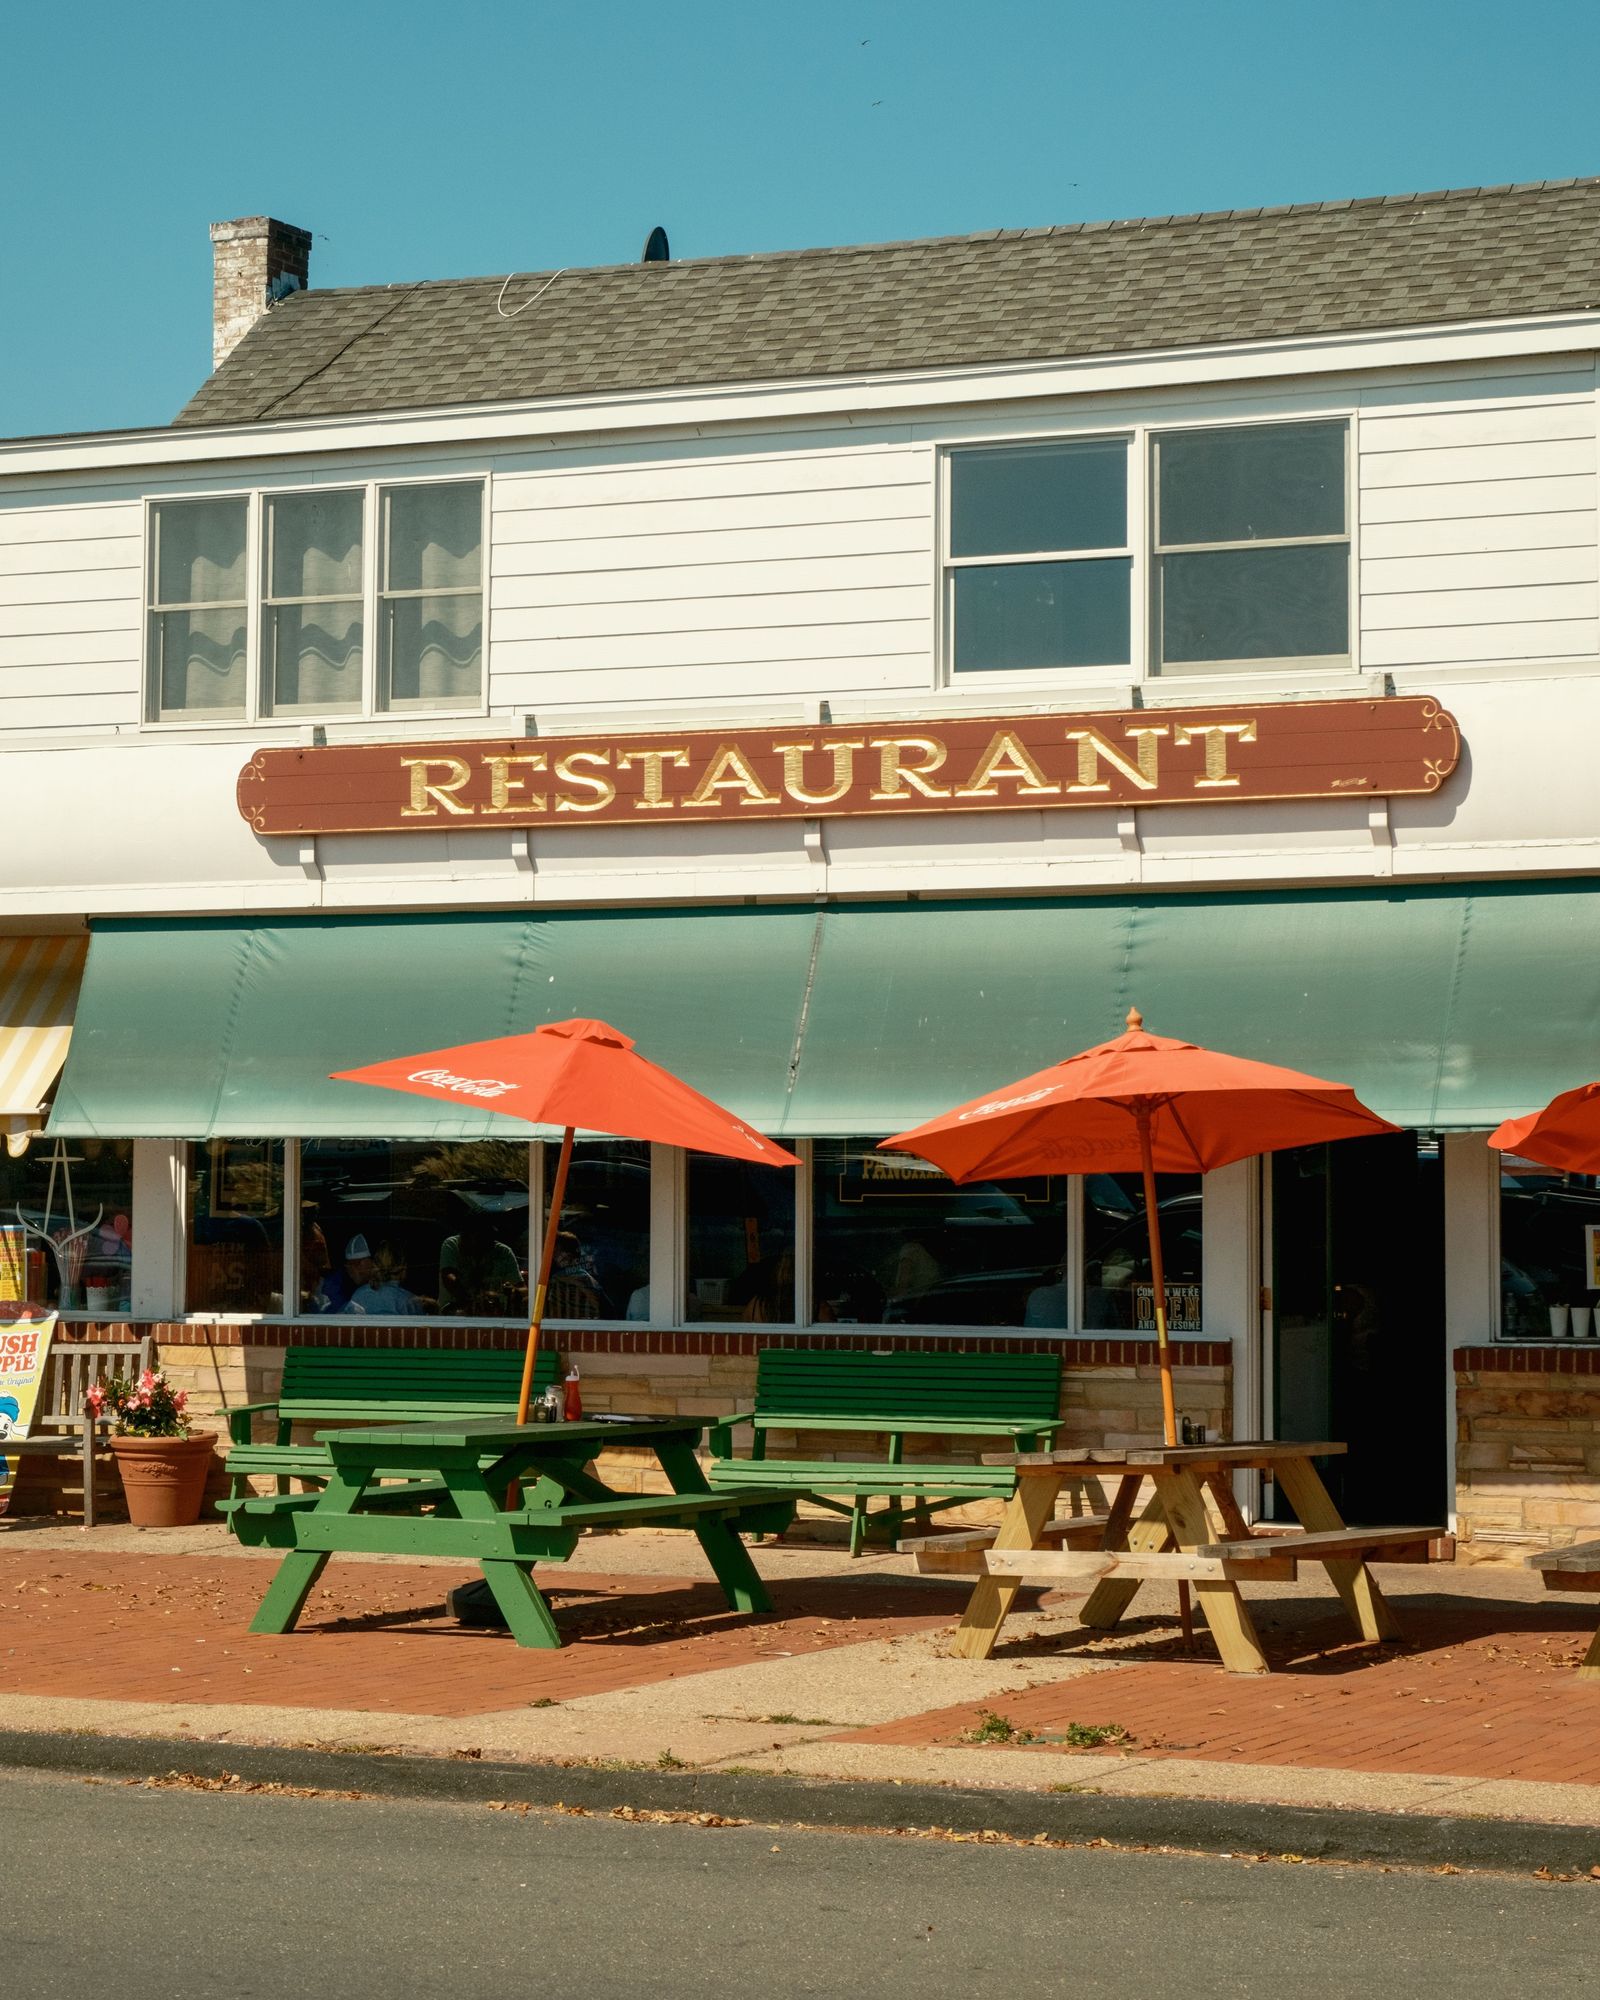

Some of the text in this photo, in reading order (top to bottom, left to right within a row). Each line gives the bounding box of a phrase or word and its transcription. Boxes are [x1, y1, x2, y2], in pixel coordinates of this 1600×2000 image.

[400, 718, 1258, 817] RESTAURANT
[407, 1069, 522, 1098] Coca-Cola
[1137, 1287, 1153, 1296] COM
[1137, 1296, 1200, 1321] OEN
[1166, 1321, 1201, 1330] WESOME
